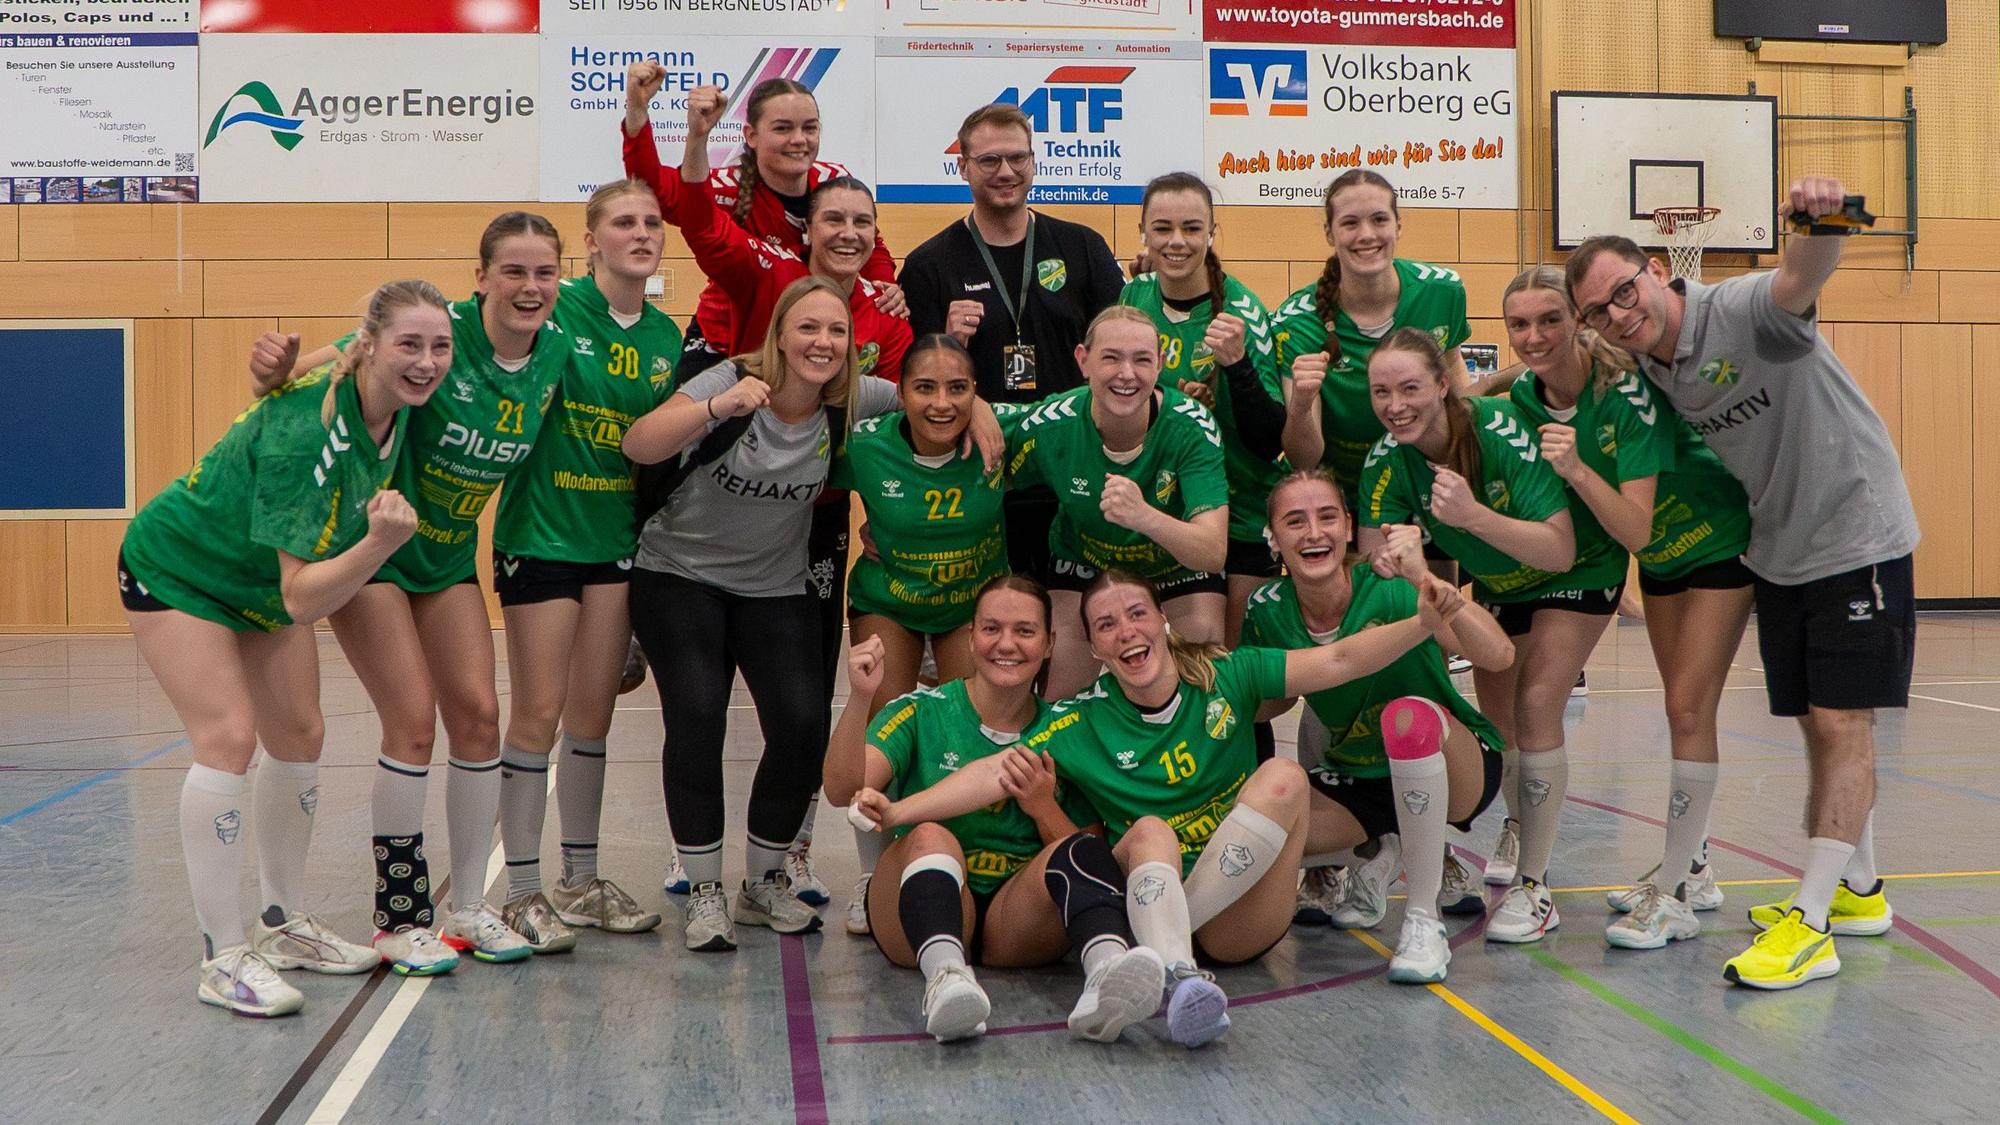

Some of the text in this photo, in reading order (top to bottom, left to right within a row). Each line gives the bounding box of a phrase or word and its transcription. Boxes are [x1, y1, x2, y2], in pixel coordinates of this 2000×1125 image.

[0, 12, 57, 25] Polos,
[64, 12, 112, 25] Caps
[119, 12, 153, 22] und
[1216, 6, 1504, 29] www.toyota-gummersbach.de
[0, 35, 131, 46] rs bauen & renovieren
[907, 41, 1171, 54] Fördertechnik Separiersysteme Automation
[571, 46, 695, 66] Hermann
[6, 60, 175, 71] Besuchen Sie unsere Ausstellung
[1322, 53, 1472, 82] Volksbank
[38, 85, 72, 94] Fenster
[571, 72, 729, 92] SCHFED
[59, 97, 91, 106] Fliesen
[291, 87, 534, 124] AggerEnergie
[571, 98, 617, 110] GmbH
[1323, 86, 1511, 121] Oberberg eG
[79, 110, 112, 118] Mosaik
[99, 122, 146, 131] Naturstein
[122, 134, 156, 143] Pflaster
[320, 130, 484, 145] Erdgas Strom Wasser
[147, 147, 166, 155] etc.
[1044, 140, 1121, 157] Technik
[10, 158, 171, 168] www.baustoffe-weidemann.de
[1218, 136, 1504, 178] Auch hier sind wir für Sie da!
[1034, 162, 1122, 180] Ihren Erfolg
[1442, 186, 1465, 200] 5-7
[607, 343, 639, 380] 30
[1013, 353, 1025, 375] D
[495, 399, 525, 435] 21
[925, 488, 964, 520] 22
[1159, 741, 1197, 785] 15
